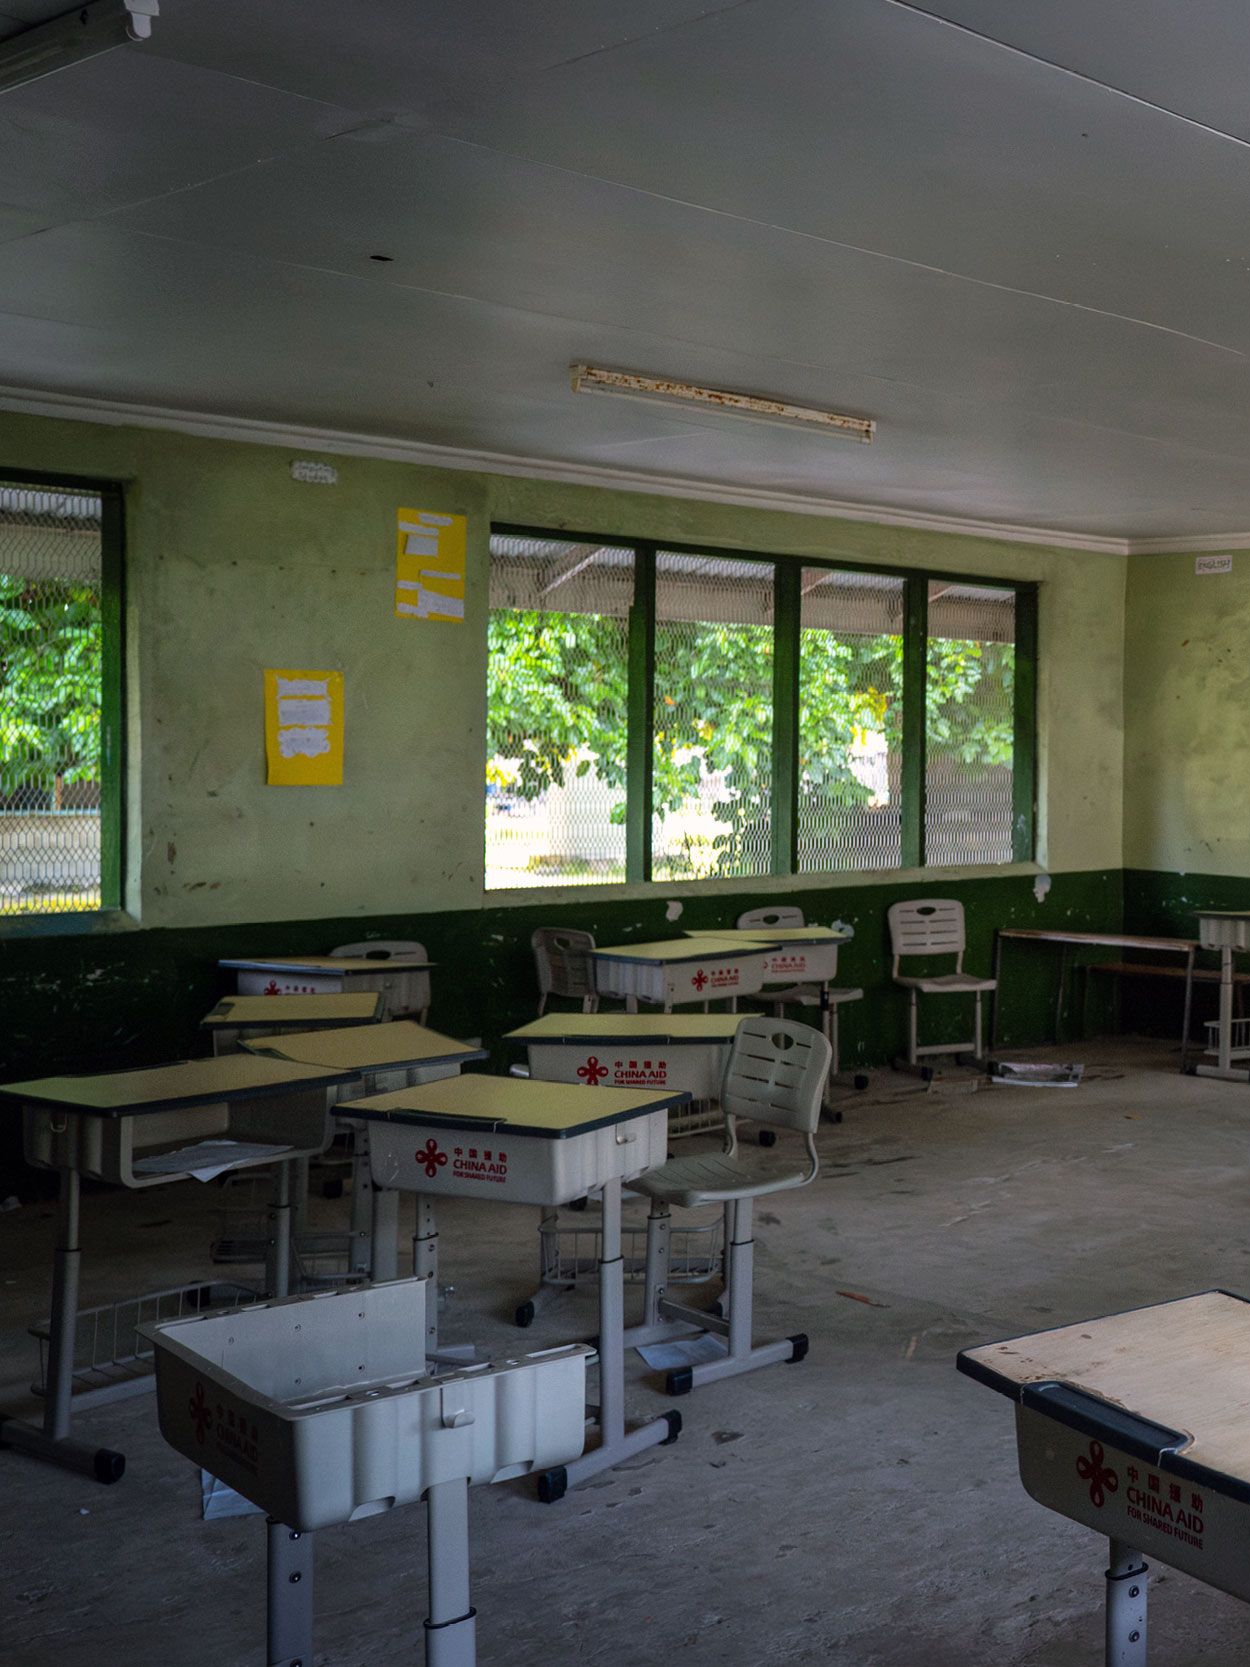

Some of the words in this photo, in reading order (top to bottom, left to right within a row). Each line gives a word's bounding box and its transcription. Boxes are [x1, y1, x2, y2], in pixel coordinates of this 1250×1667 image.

[614, 1070, 647, 1078] CHINA
[648, 1070, 667, 1078] AID
[453, 1147, 508, 1163] 中国援助
[453, 1159, 487, 1172] CHINA
[488, 1164, 508, 1175] AID
[453, 1170, 464, 1178] FOR
[464, 1172, 486, 1180] SHARED
[486, 1174, 506, 1183] FUTURE
[1127, 1486, 1174, 1522] CHINA
[1176, 1508, 1204, 1534] AID
[1128, 1506, 1142, 1520] FOR
[1143, 1513, 1172, 1536] SHARED
[1174, 1527, 1204, 1550] FUTURE
